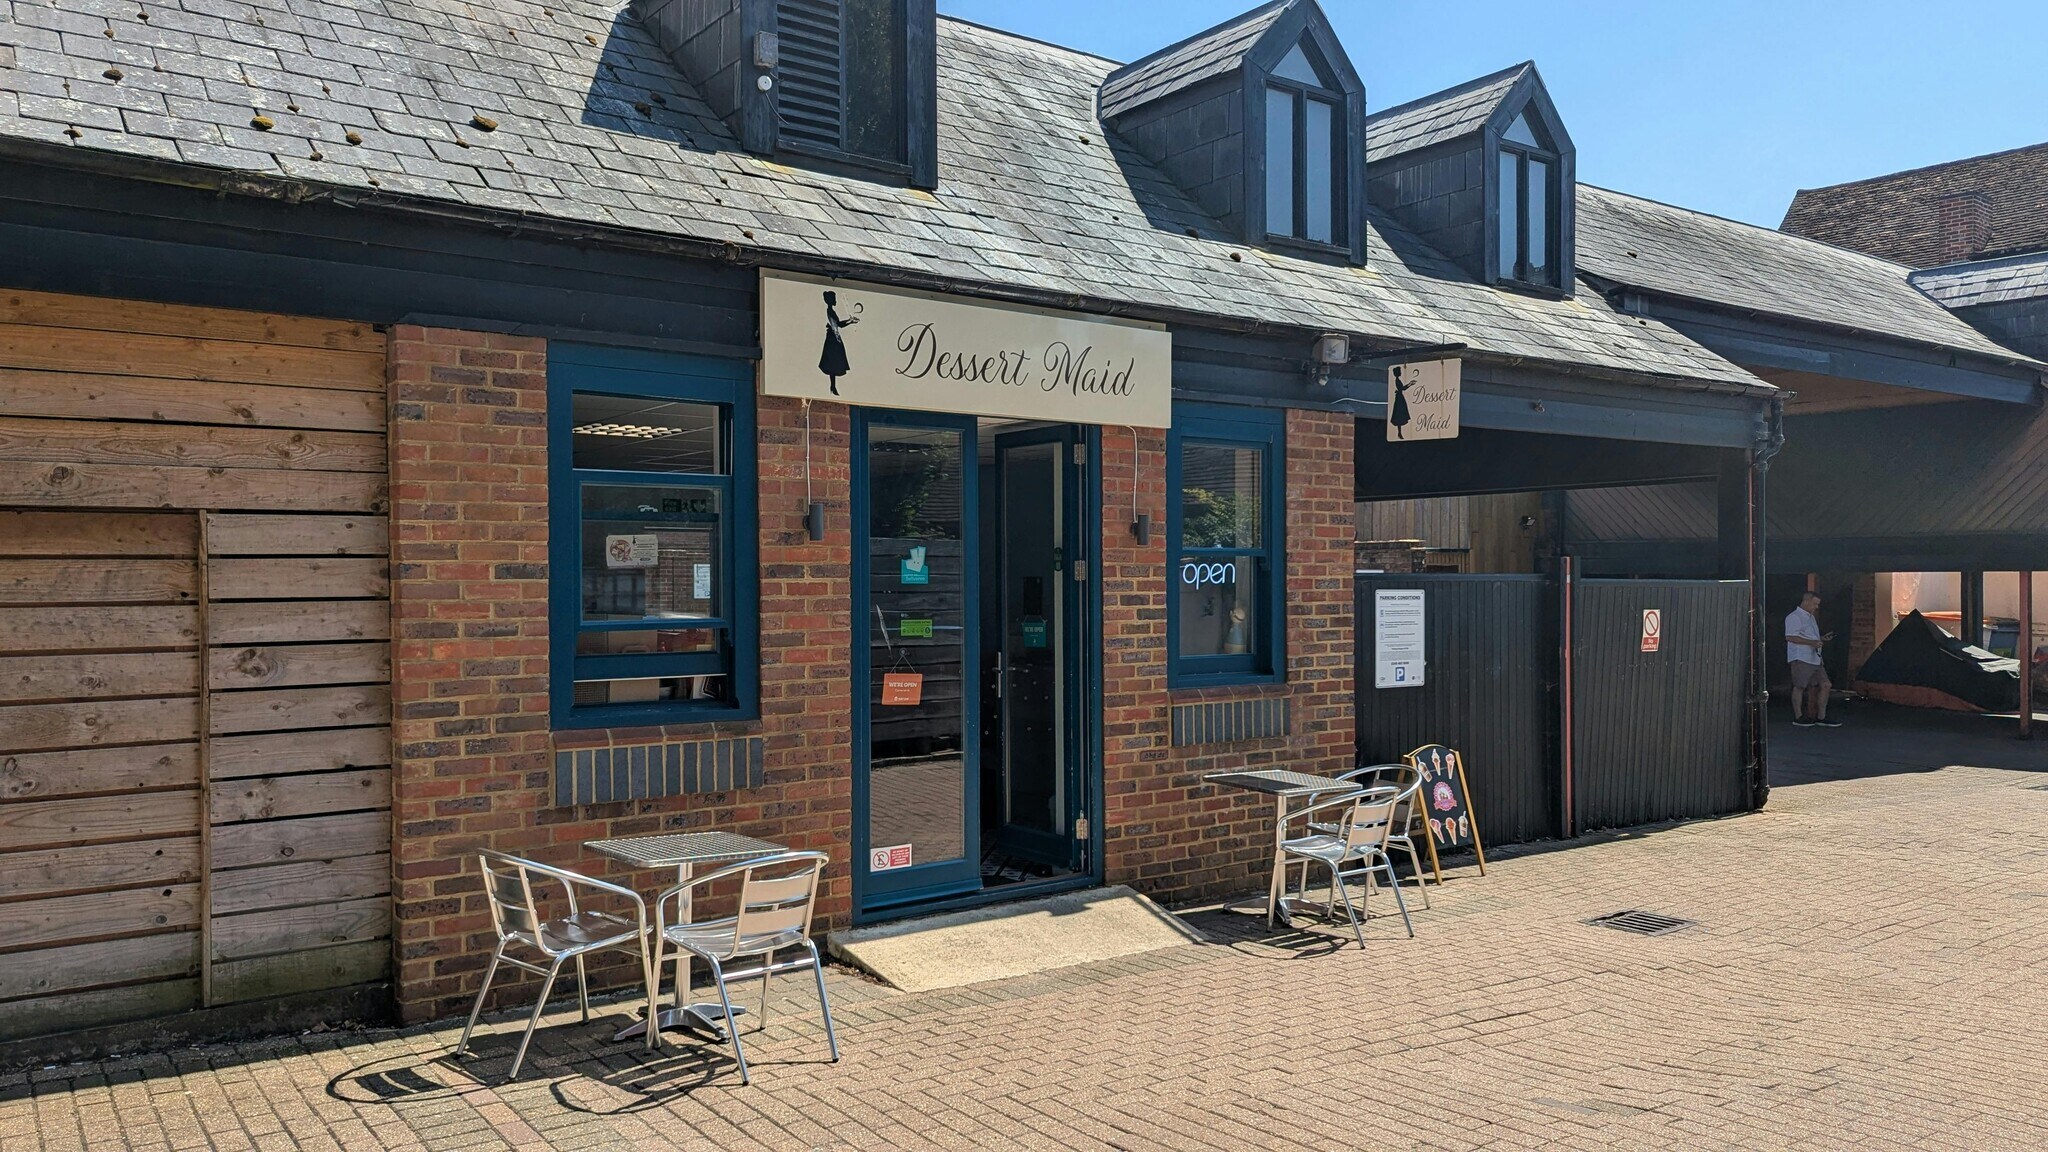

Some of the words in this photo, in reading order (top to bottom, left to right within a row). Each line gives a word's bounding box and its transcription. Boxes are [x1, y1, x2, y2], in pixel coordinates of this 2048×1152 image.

[895, 322, 1030, 387] Dessert
[1040, 341, 1136, 397] Maid
[1412, 385, 1456, 405] Dessert
[1415, 413, 1451, 432] Maid
[1182, 563, 1236, 590] open
